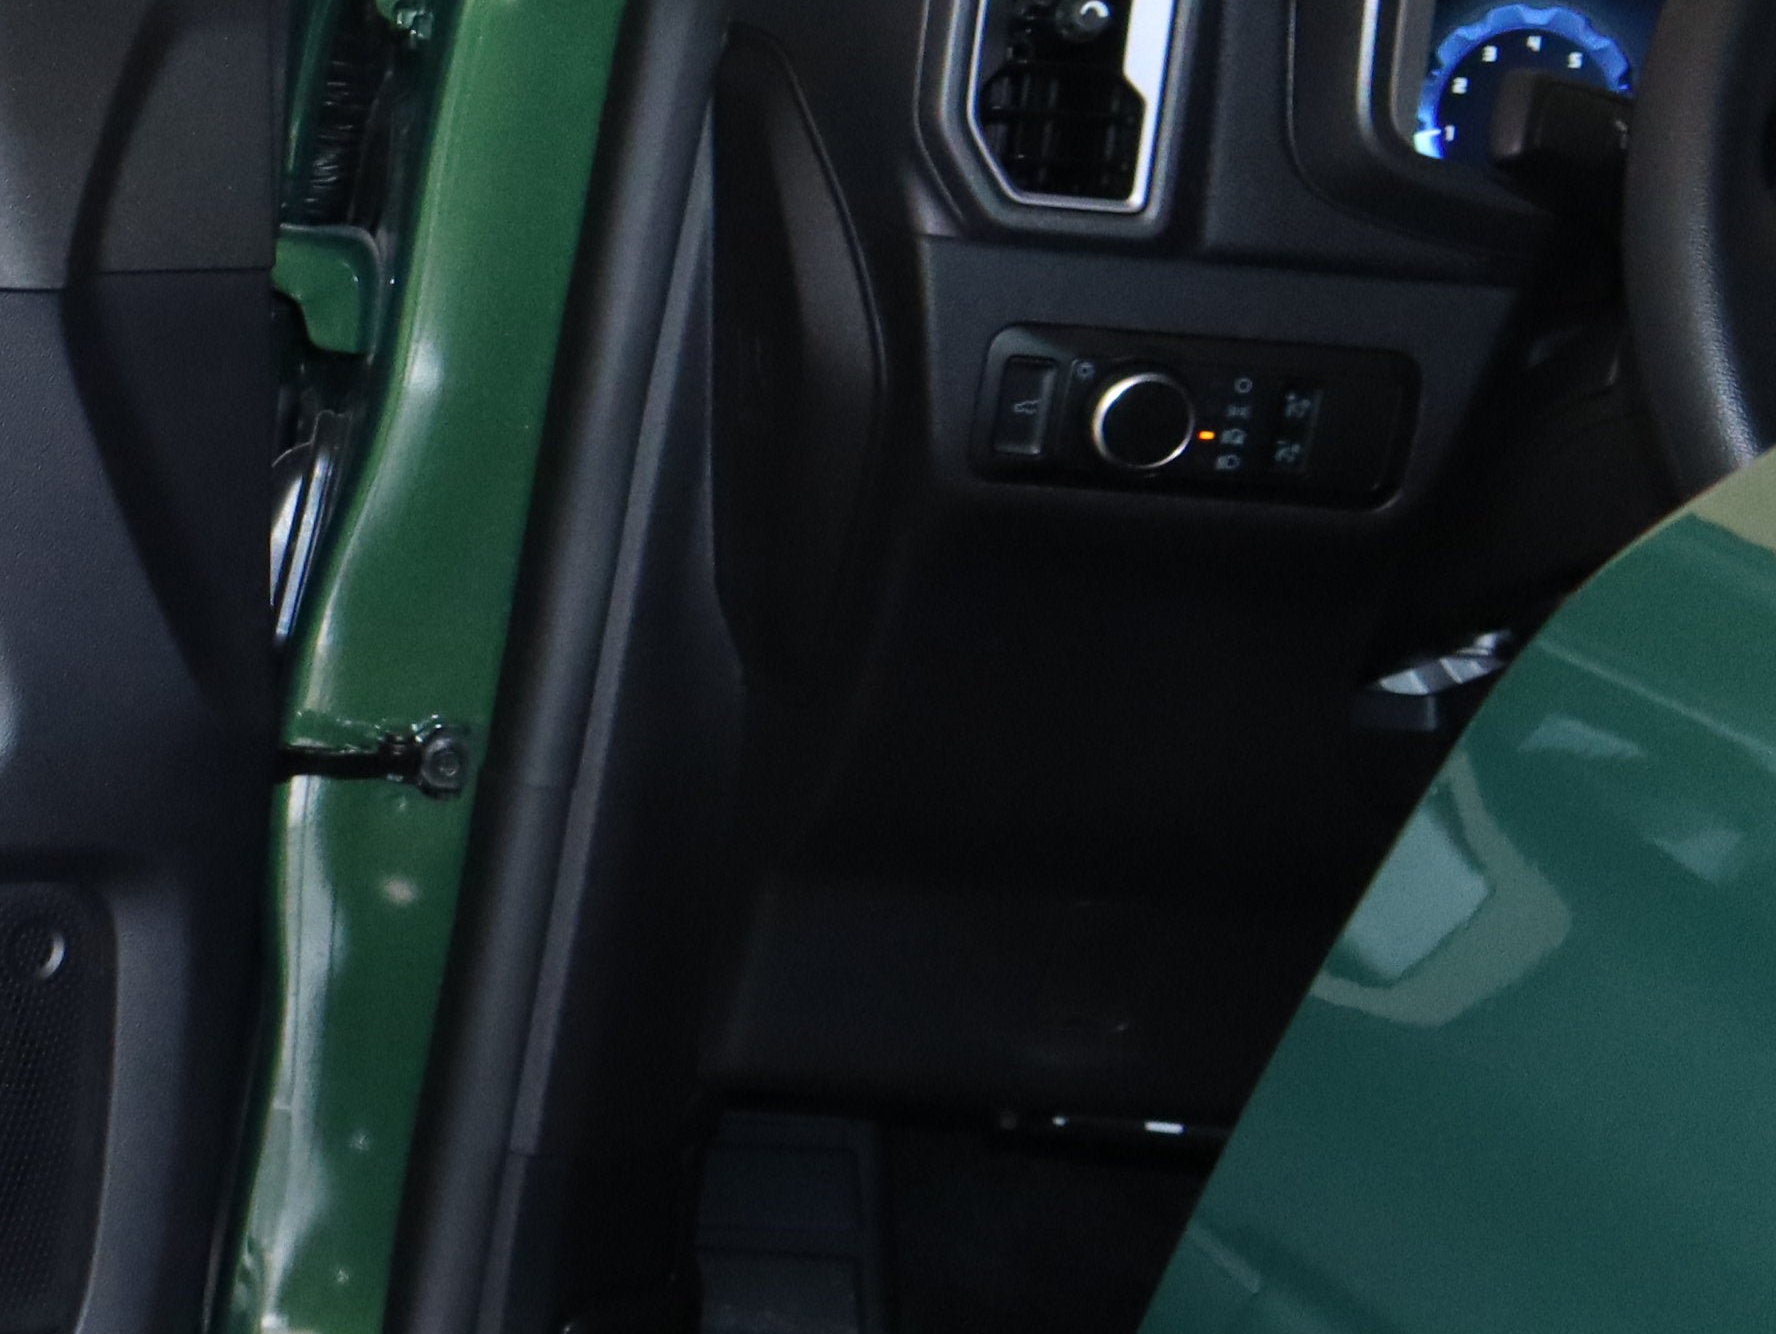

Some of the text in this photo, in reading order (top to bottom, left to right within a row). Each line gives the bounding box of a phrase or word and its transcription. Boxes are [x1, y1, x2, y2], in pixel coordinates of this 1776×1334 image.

[1527, 35, 1542, 52] 4
[1481, 45, 1497, 62] 3
[1567, 52, 1583, 69] 5
[1451, 77, 1467, 94] 2
